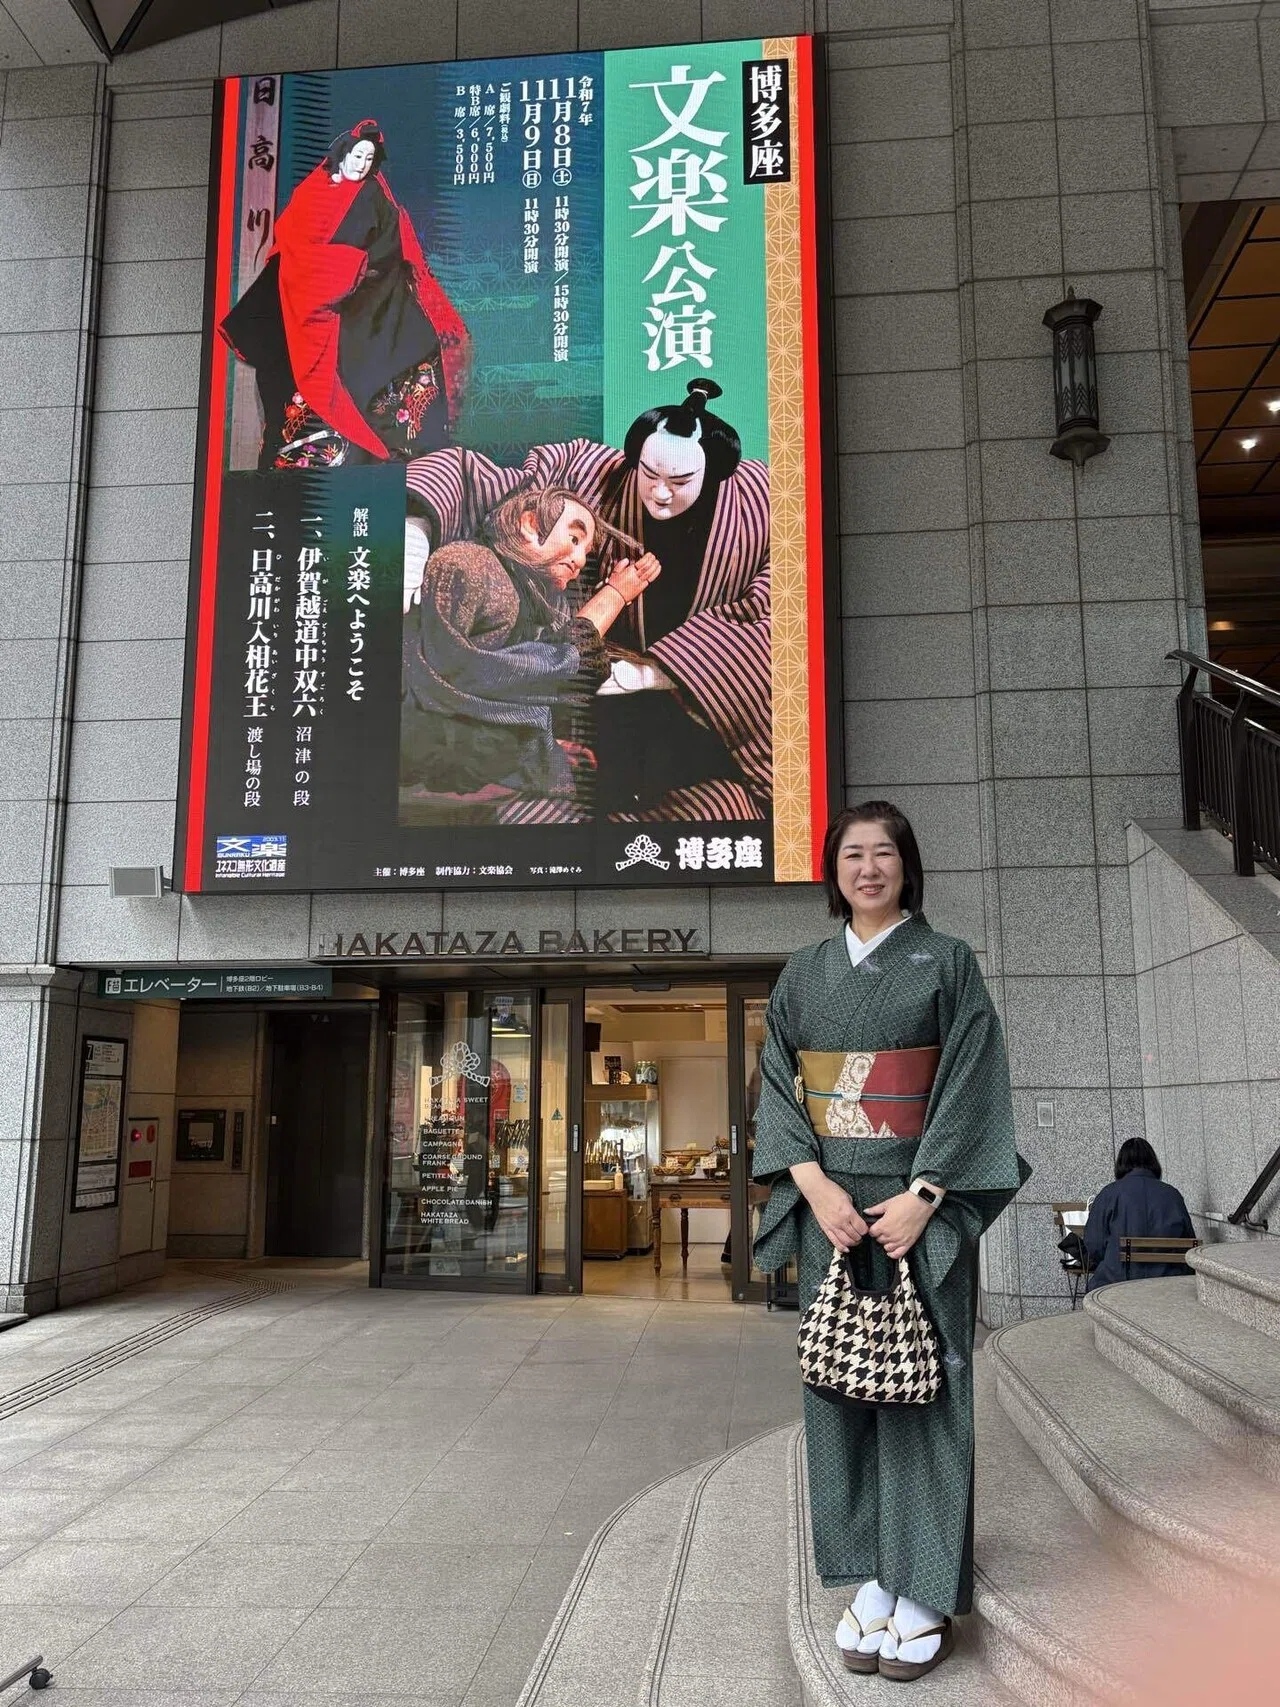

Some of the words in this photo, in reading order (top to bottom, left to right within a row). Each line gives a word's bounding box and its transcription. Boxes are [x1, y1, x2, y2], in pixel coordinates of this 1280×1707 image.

[578, 76, 594, 126] 令和7年
[749, 65, 784, 179] 博多座
[246, 77, 276, 272] 日高川
[523, 197, 540, 274] 11時30分開演
[628, 65, 730, 372] 文楽公演
[353, 507, 369, 537] 解説
[346, 546, 371, 701] 文楽へようこそ
[243, 726, 264, 807] 渡し場の段
[293, 726, 312, 806] 沼津の段
[215, 859, 286, 873] ユネスコ無形文化遺産
[675, 835, 764, 870] 博多座
[538, 928, 699, 953] BAKERY
[124, 976, 217, 993] エレベーター
